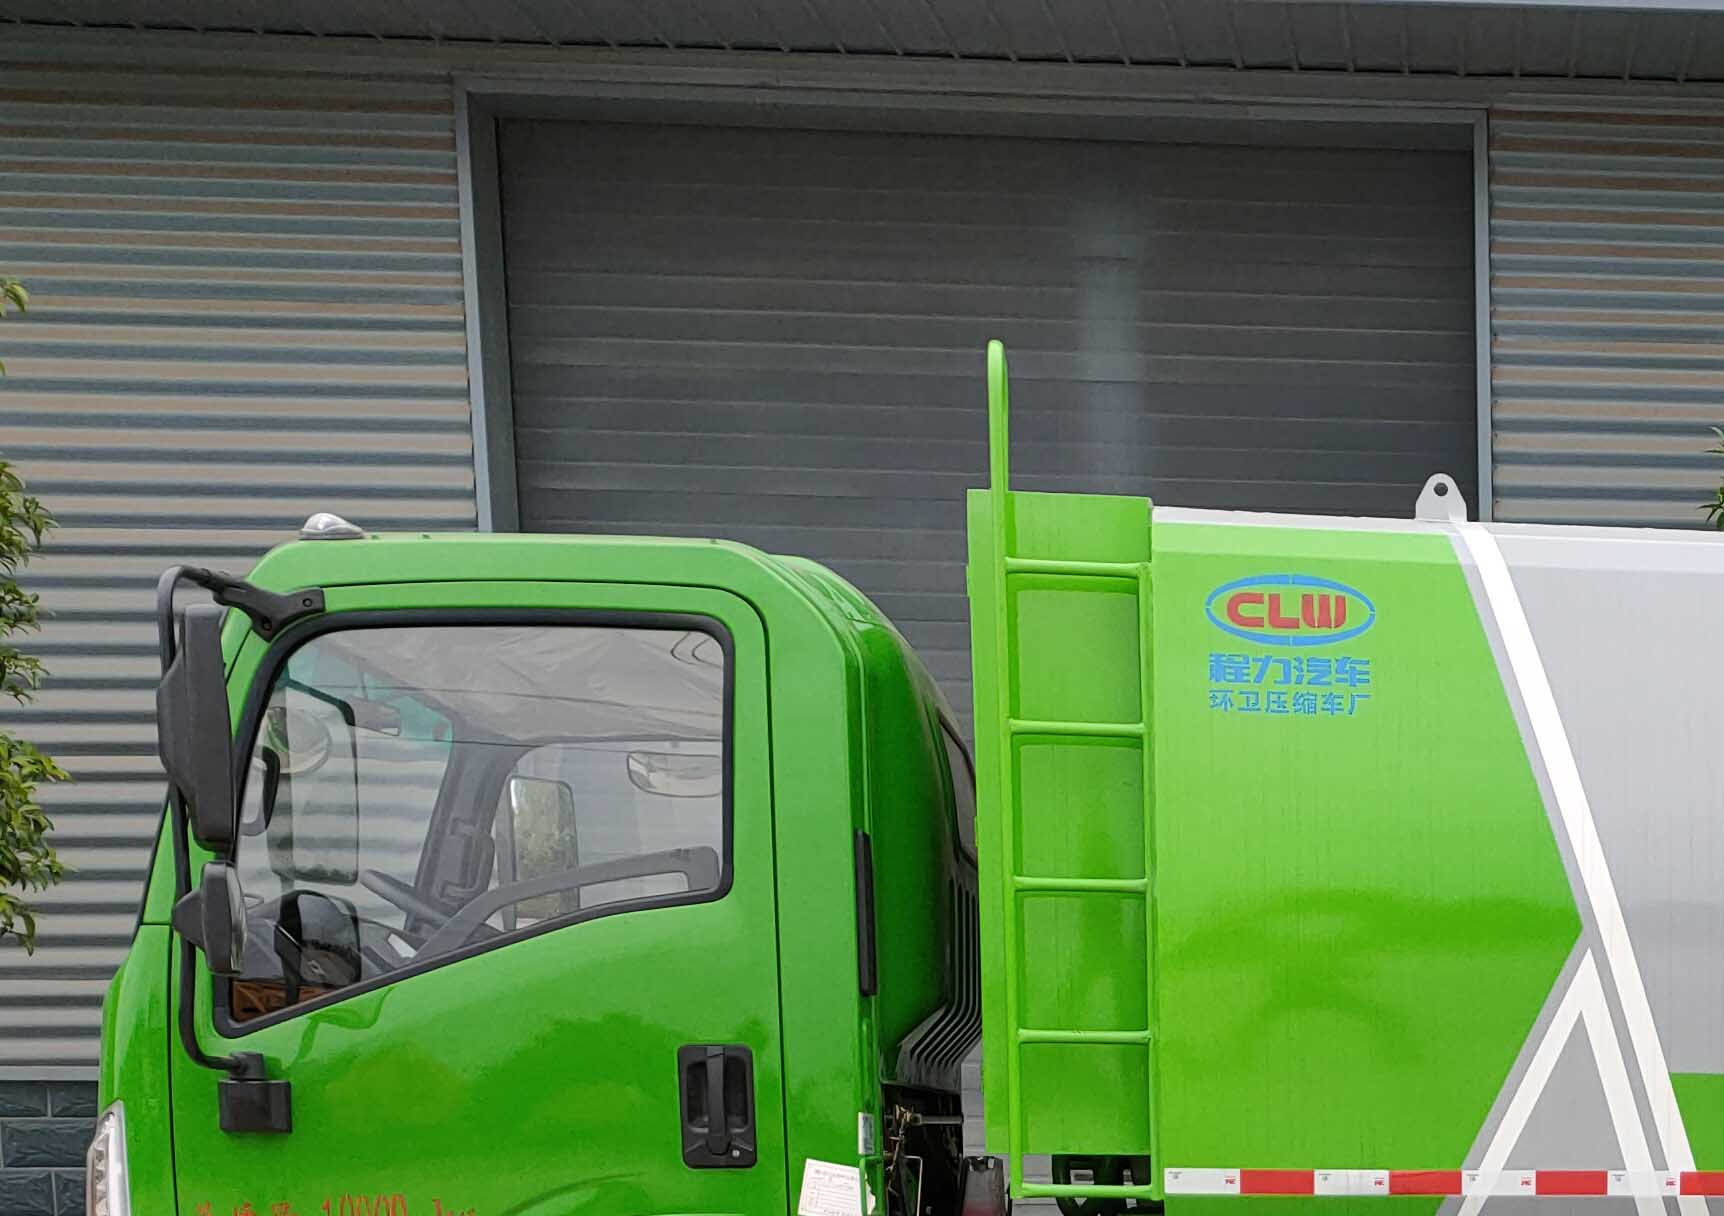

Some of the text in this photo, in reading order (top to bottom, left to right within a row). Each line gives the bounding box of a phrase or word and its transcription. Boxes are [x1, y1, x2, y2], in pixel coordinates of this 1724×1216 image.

[1227, 592, 1346, 629] CLW
[1208, 653, 1370, 687] 程力汽车
[1208, 690, 1371, 715] 环卫压缩车厂
